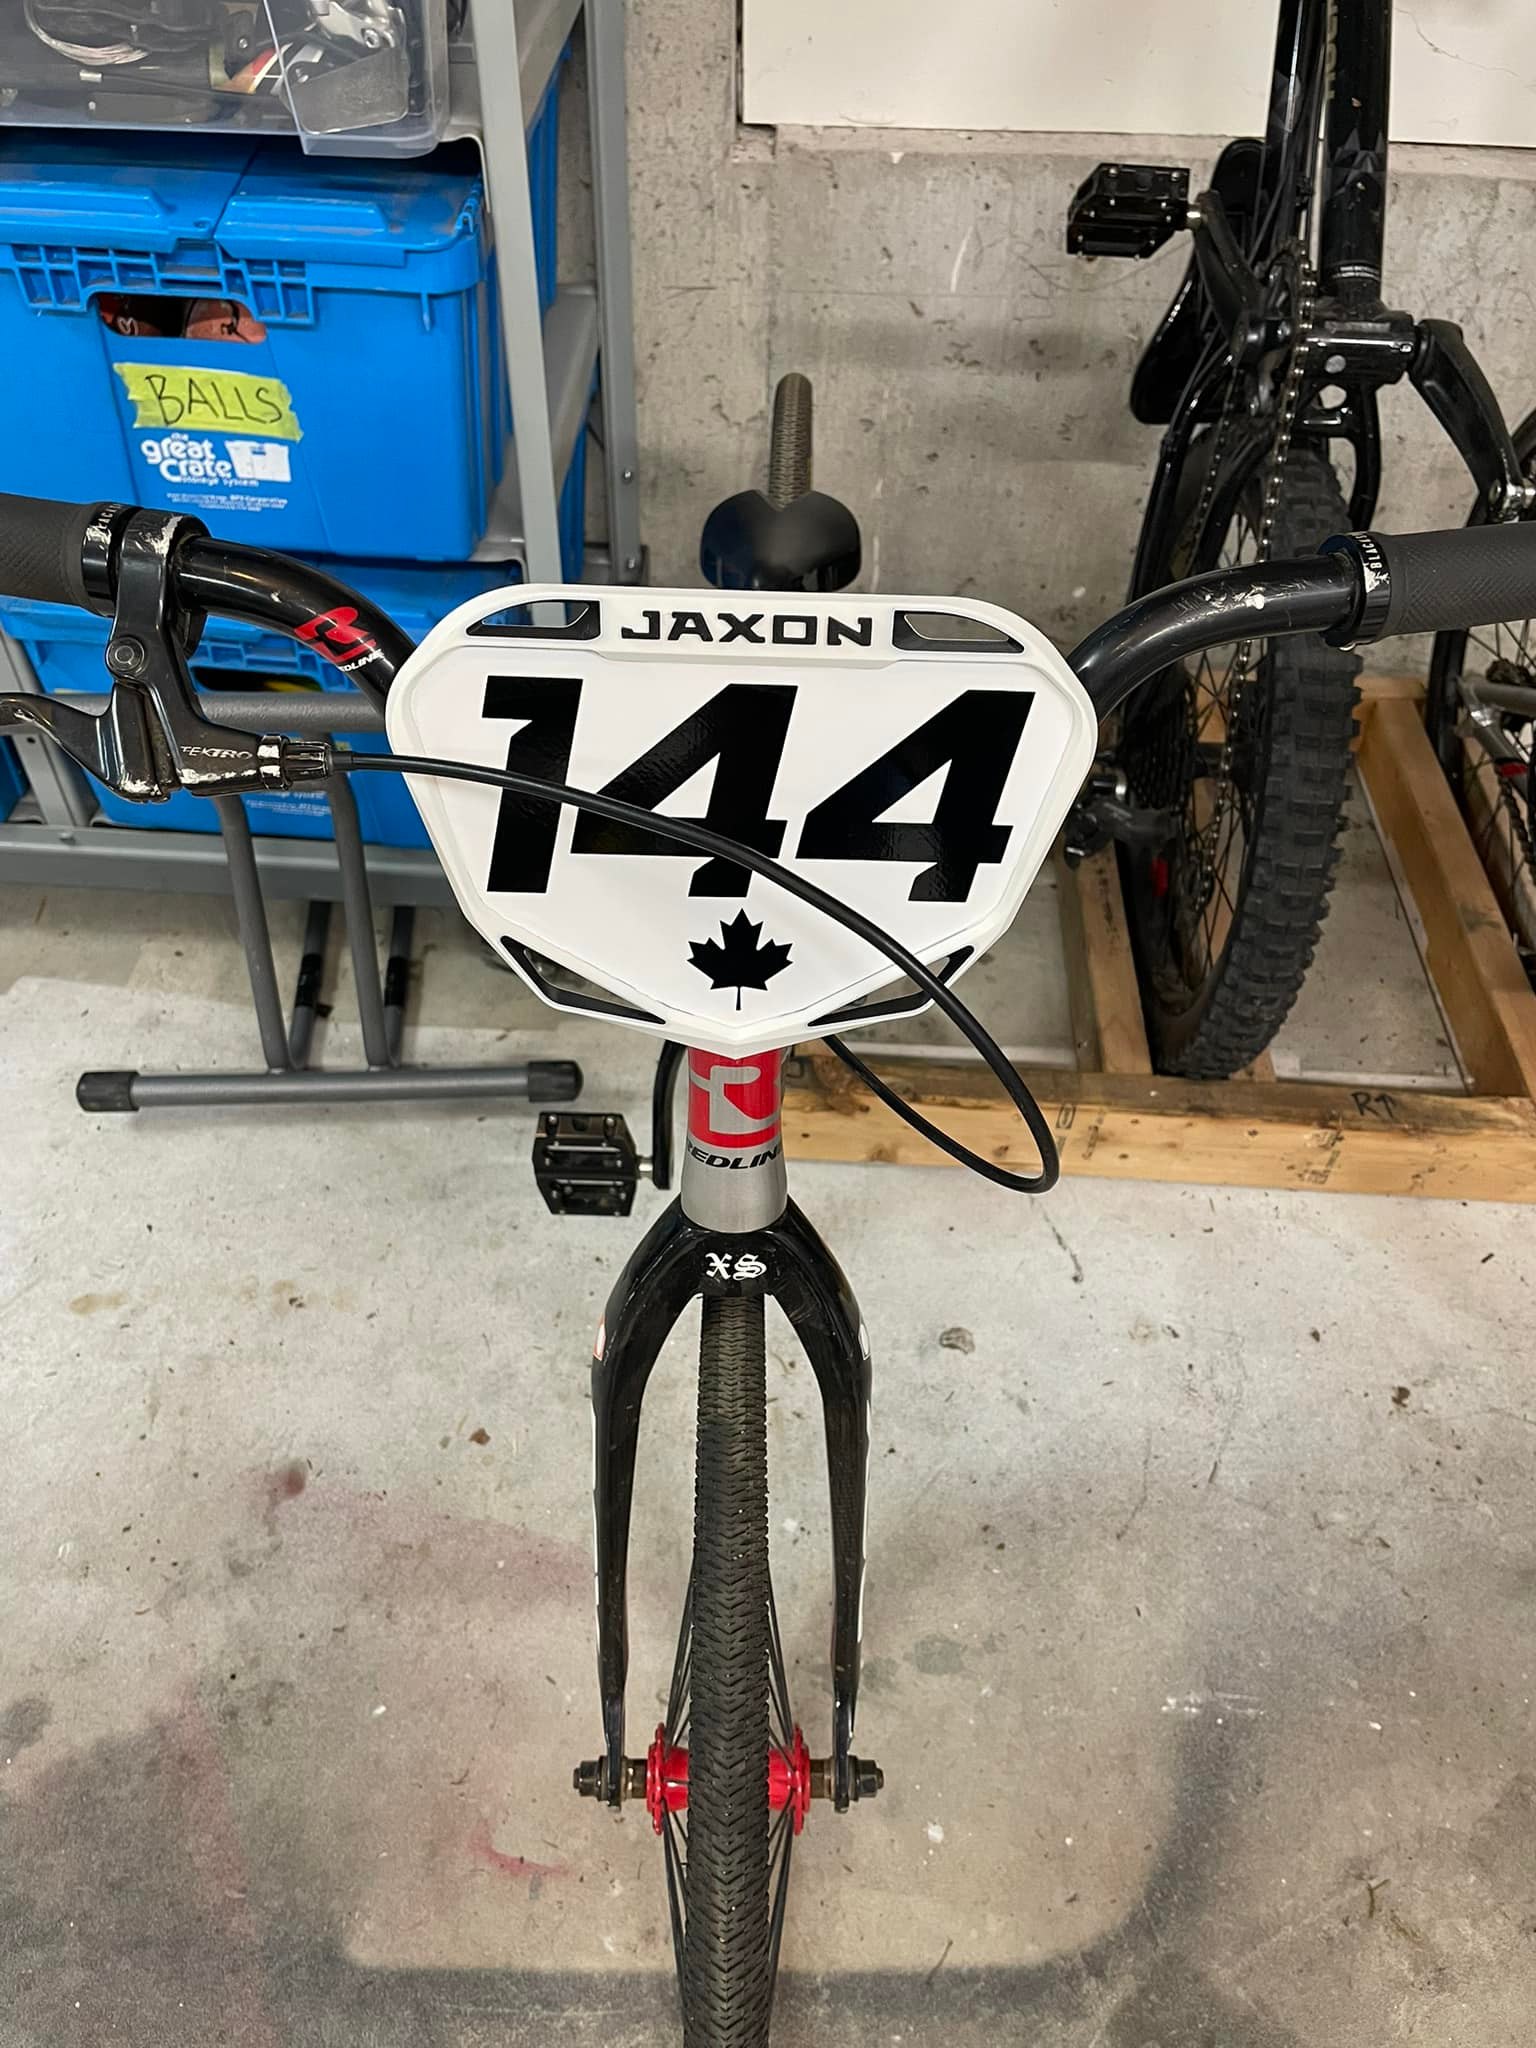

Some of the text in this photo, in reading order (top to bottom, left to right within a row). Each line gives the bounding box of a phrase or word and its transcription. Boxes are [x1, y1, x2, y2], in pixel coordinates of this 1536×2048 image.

[144, 374, 282, 426] BALLS
[141, 437, 215, 465] great
[620, 610, 873, 646] JAXON
[180, 745, 253, 760] TEKTRO
[481, 675, 1036, 903] 144
[687, 1141, 780, 1169] EDLIN
[705, 1252, 767, 1280] XS
